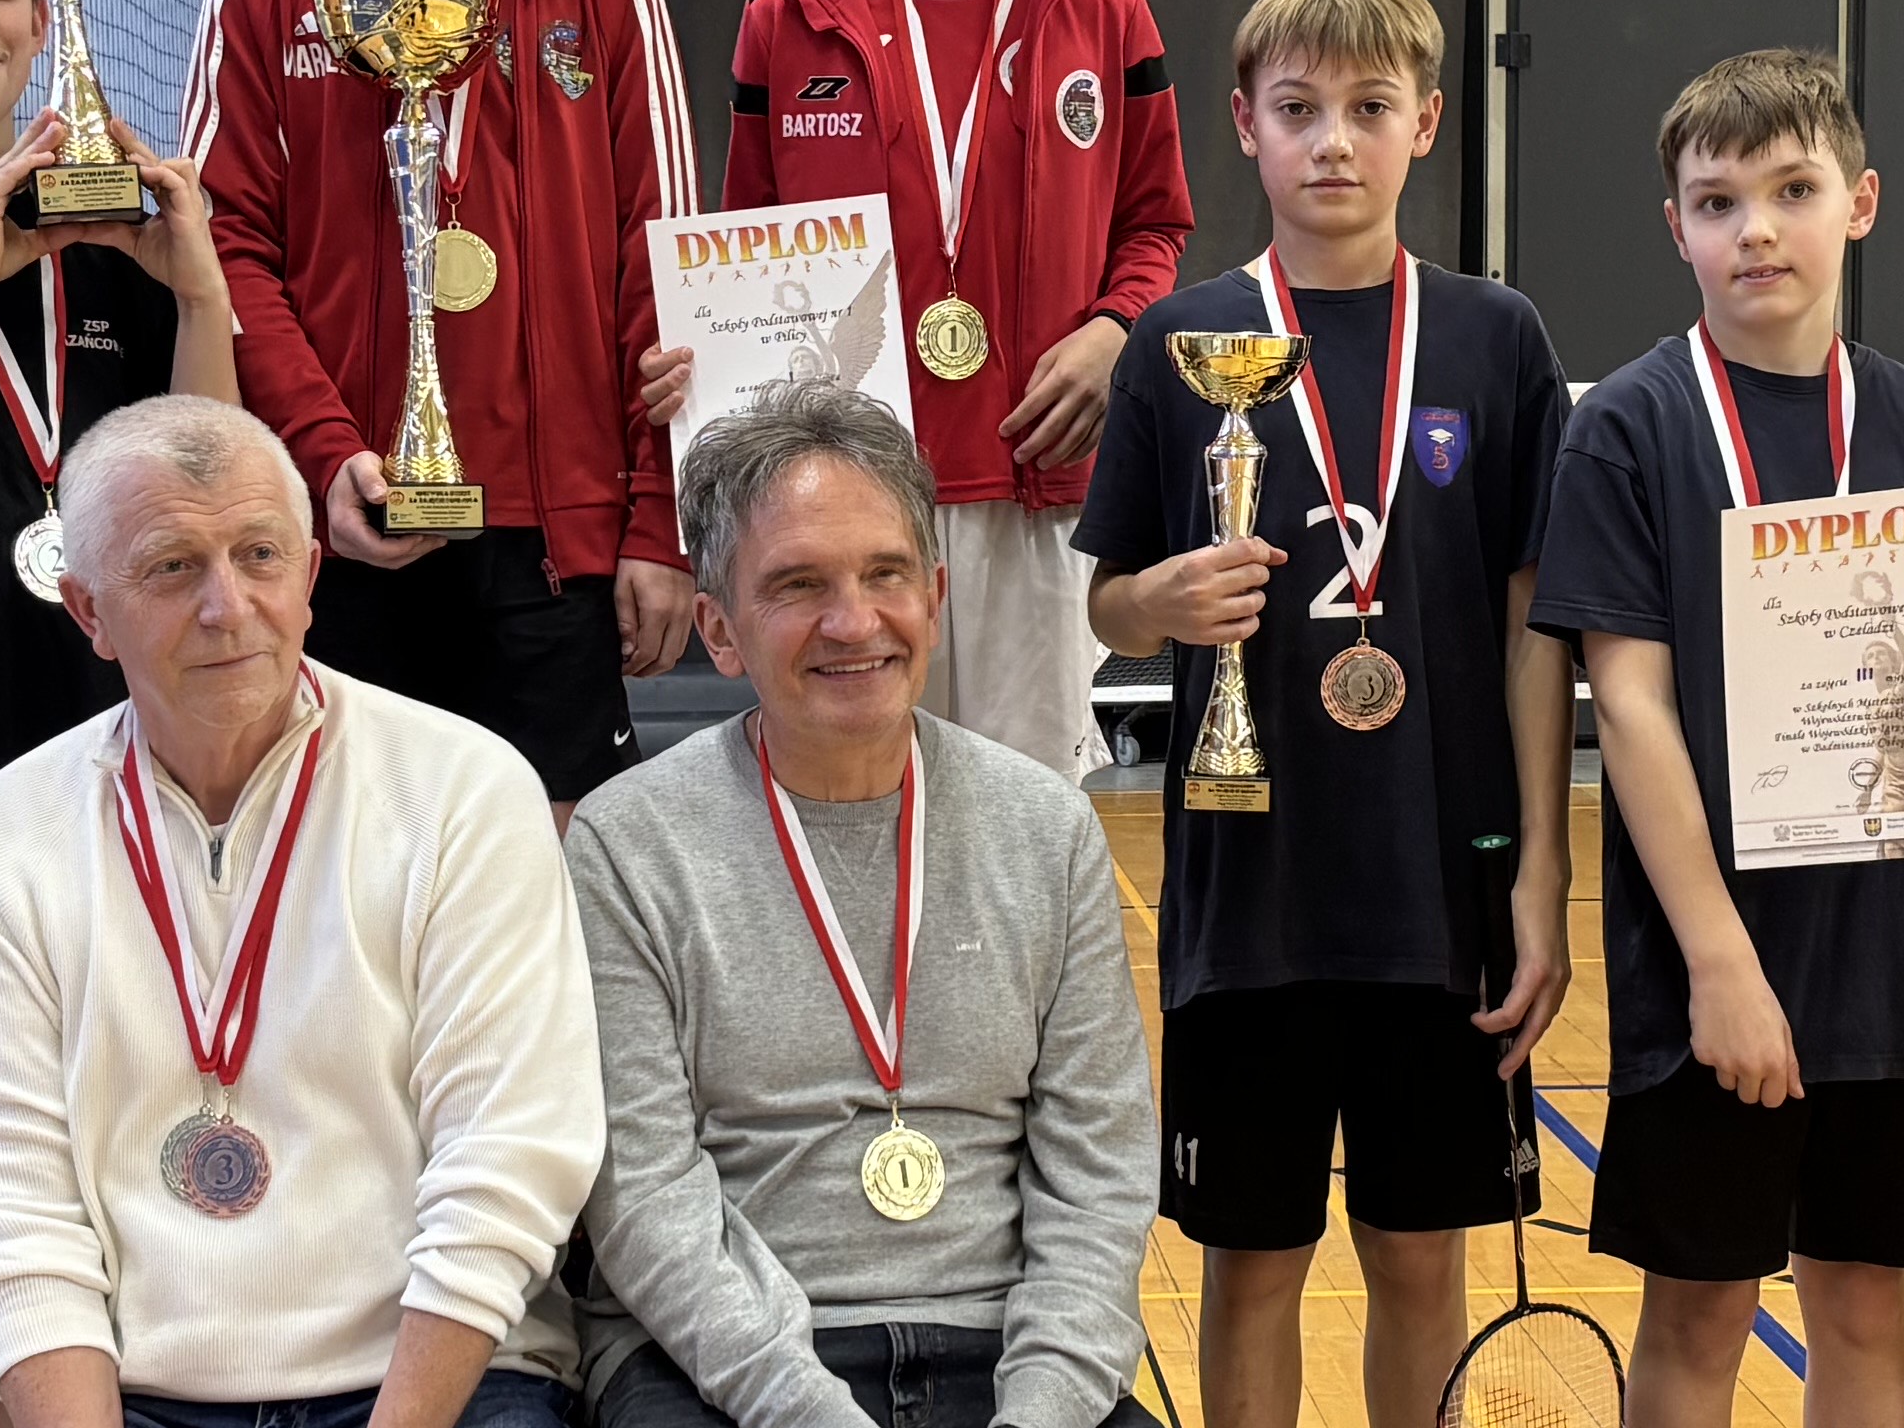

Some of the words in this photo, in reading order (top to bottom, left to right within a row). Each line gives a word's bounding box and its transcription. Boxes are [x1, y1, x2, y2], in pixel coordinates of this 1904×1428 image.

[782, 112, 864, 138] BARTOSZ
[674, 212, 869, 270] DYPLOM
[82, 319, 110, 332] ZSP
[947, 324, 958, 353] 1
[1306, 502, 1384, 619] 2
[1762, 596, 1783, 611] dla
[1358, 674, 1376, 702] 3
[1856, 667, 1874, 682] III
[214, 1153, 234, 1185] 3
[897, 1158, 910, 1189] 1
